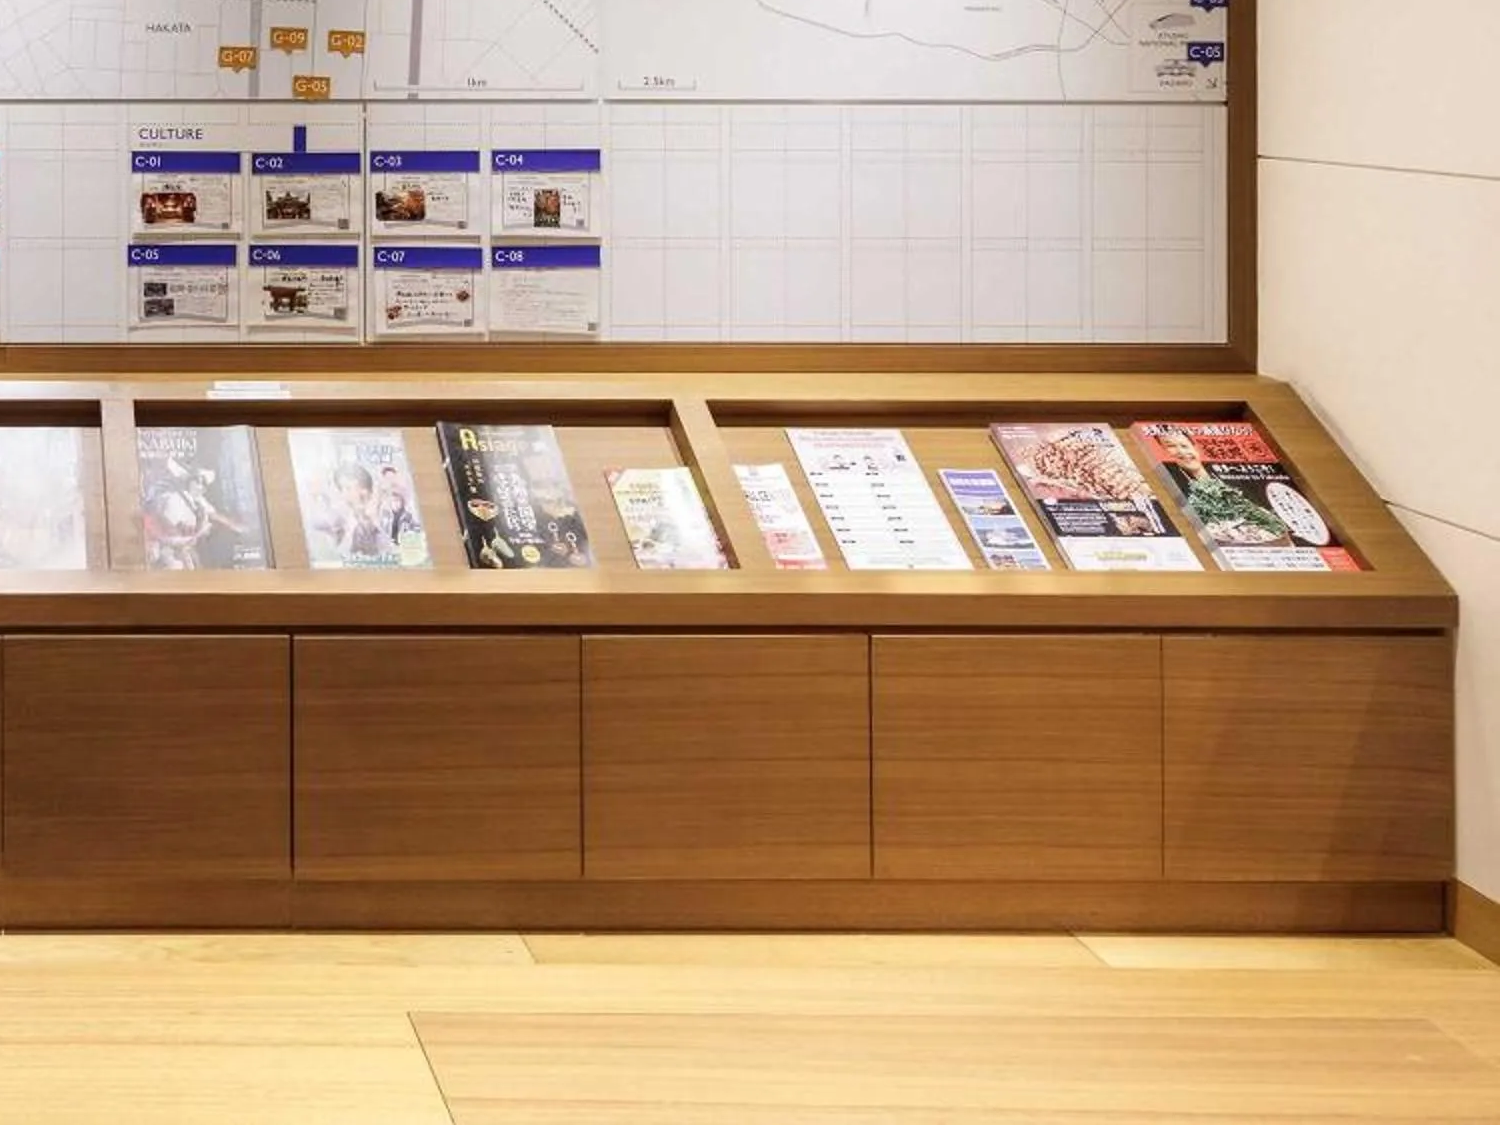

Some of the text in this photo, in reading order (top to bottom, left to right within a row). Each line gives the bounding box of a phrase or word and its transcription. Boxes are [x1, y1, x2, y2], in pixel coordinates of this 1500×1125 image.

[146, 24, 192, 33] HAKATA
[274, 32, 305, 44] G-09
[332, 35, 364, 48] G-02
[222, 50, 253, 63] G-07
[1190, 47, 1221, 58] C-05
[139, 128, 203, 140] CULTURE
[135, 157, 161, 166] C-01
[256, 158, 283, 168] C-02
[373, 156, 402, 166] C-03
[496, 155, 523, 165] C-04
[132, 250, 159, 260] C-05
[253, 250, 280, 260] C-06
[378, 252, 405, 262] C-07
